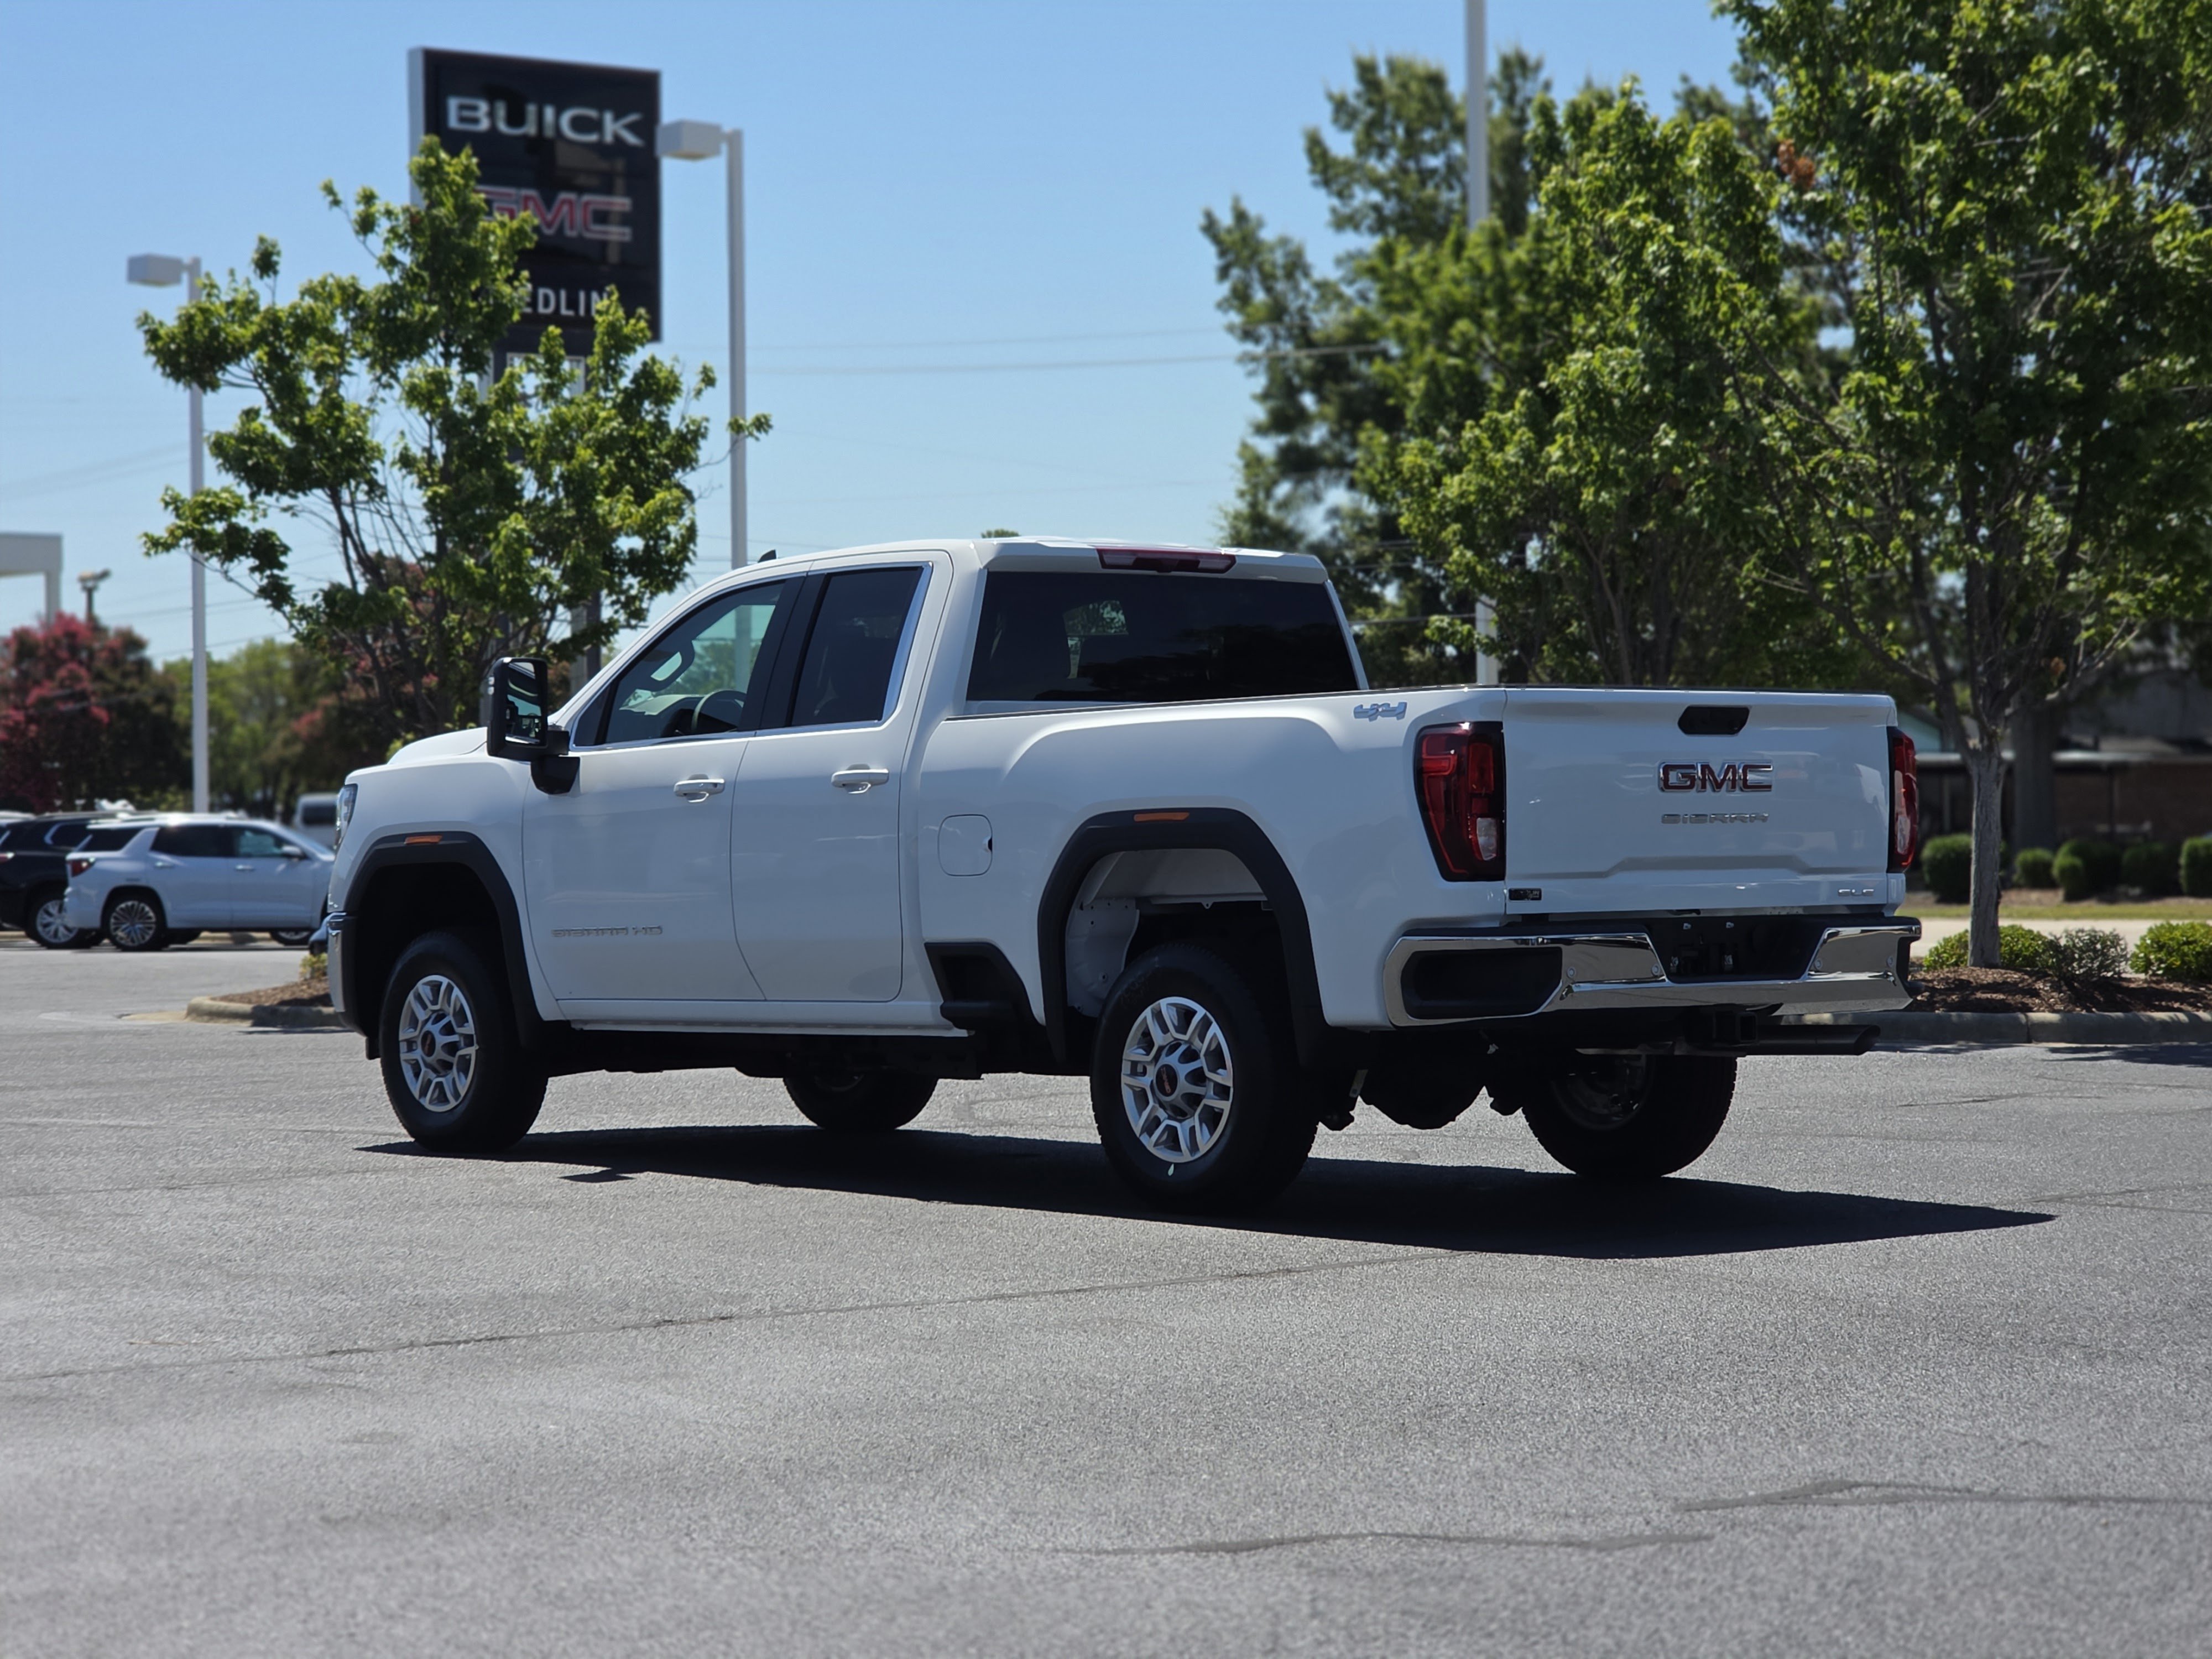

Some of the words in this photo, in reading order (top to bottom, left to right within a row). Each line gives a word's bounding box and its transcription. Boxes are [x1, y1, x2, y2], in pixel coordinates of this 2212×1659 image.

[447, 96, 645, 147] BUICK
[513, 286, 609, 318] EDLIN
[1660, 761, 1773, 792] GMC
[1661, 813, 1769, 824] SIERRA
[551, 926, 628, 937] SIERRA
[632, 925, 664, 936] HD
